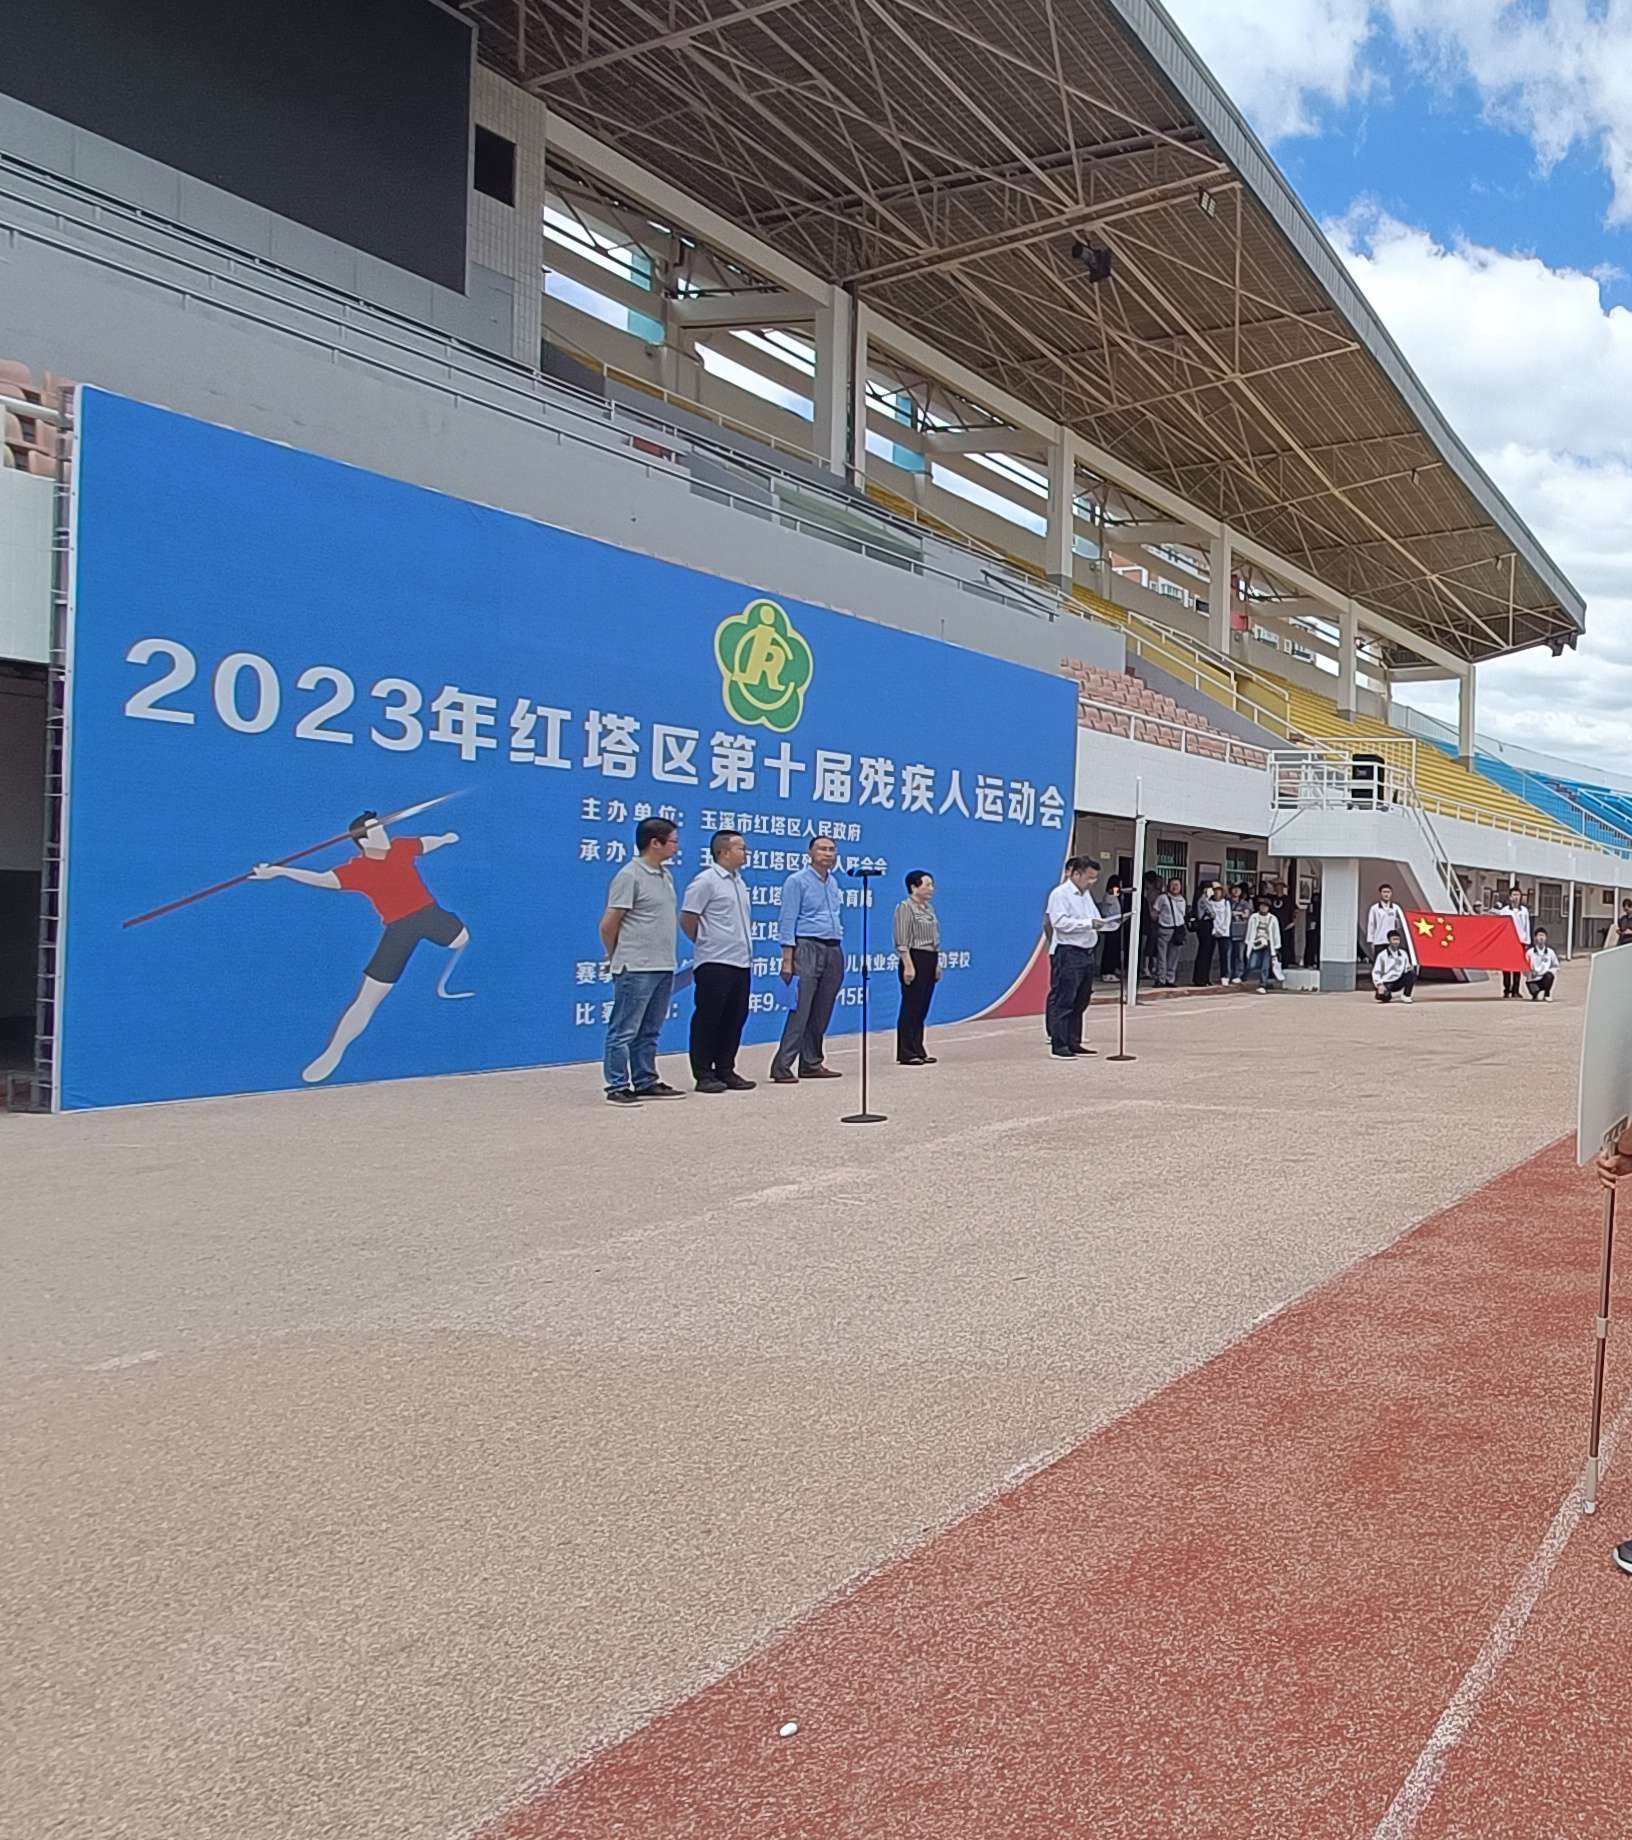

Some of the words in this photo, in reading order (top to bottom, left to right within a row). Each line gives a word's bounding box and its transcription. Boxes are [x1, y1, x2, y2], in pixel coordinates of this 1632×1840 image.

[124, 637, 1065, 829] 2023年红塔区第十届残疾人运动会
